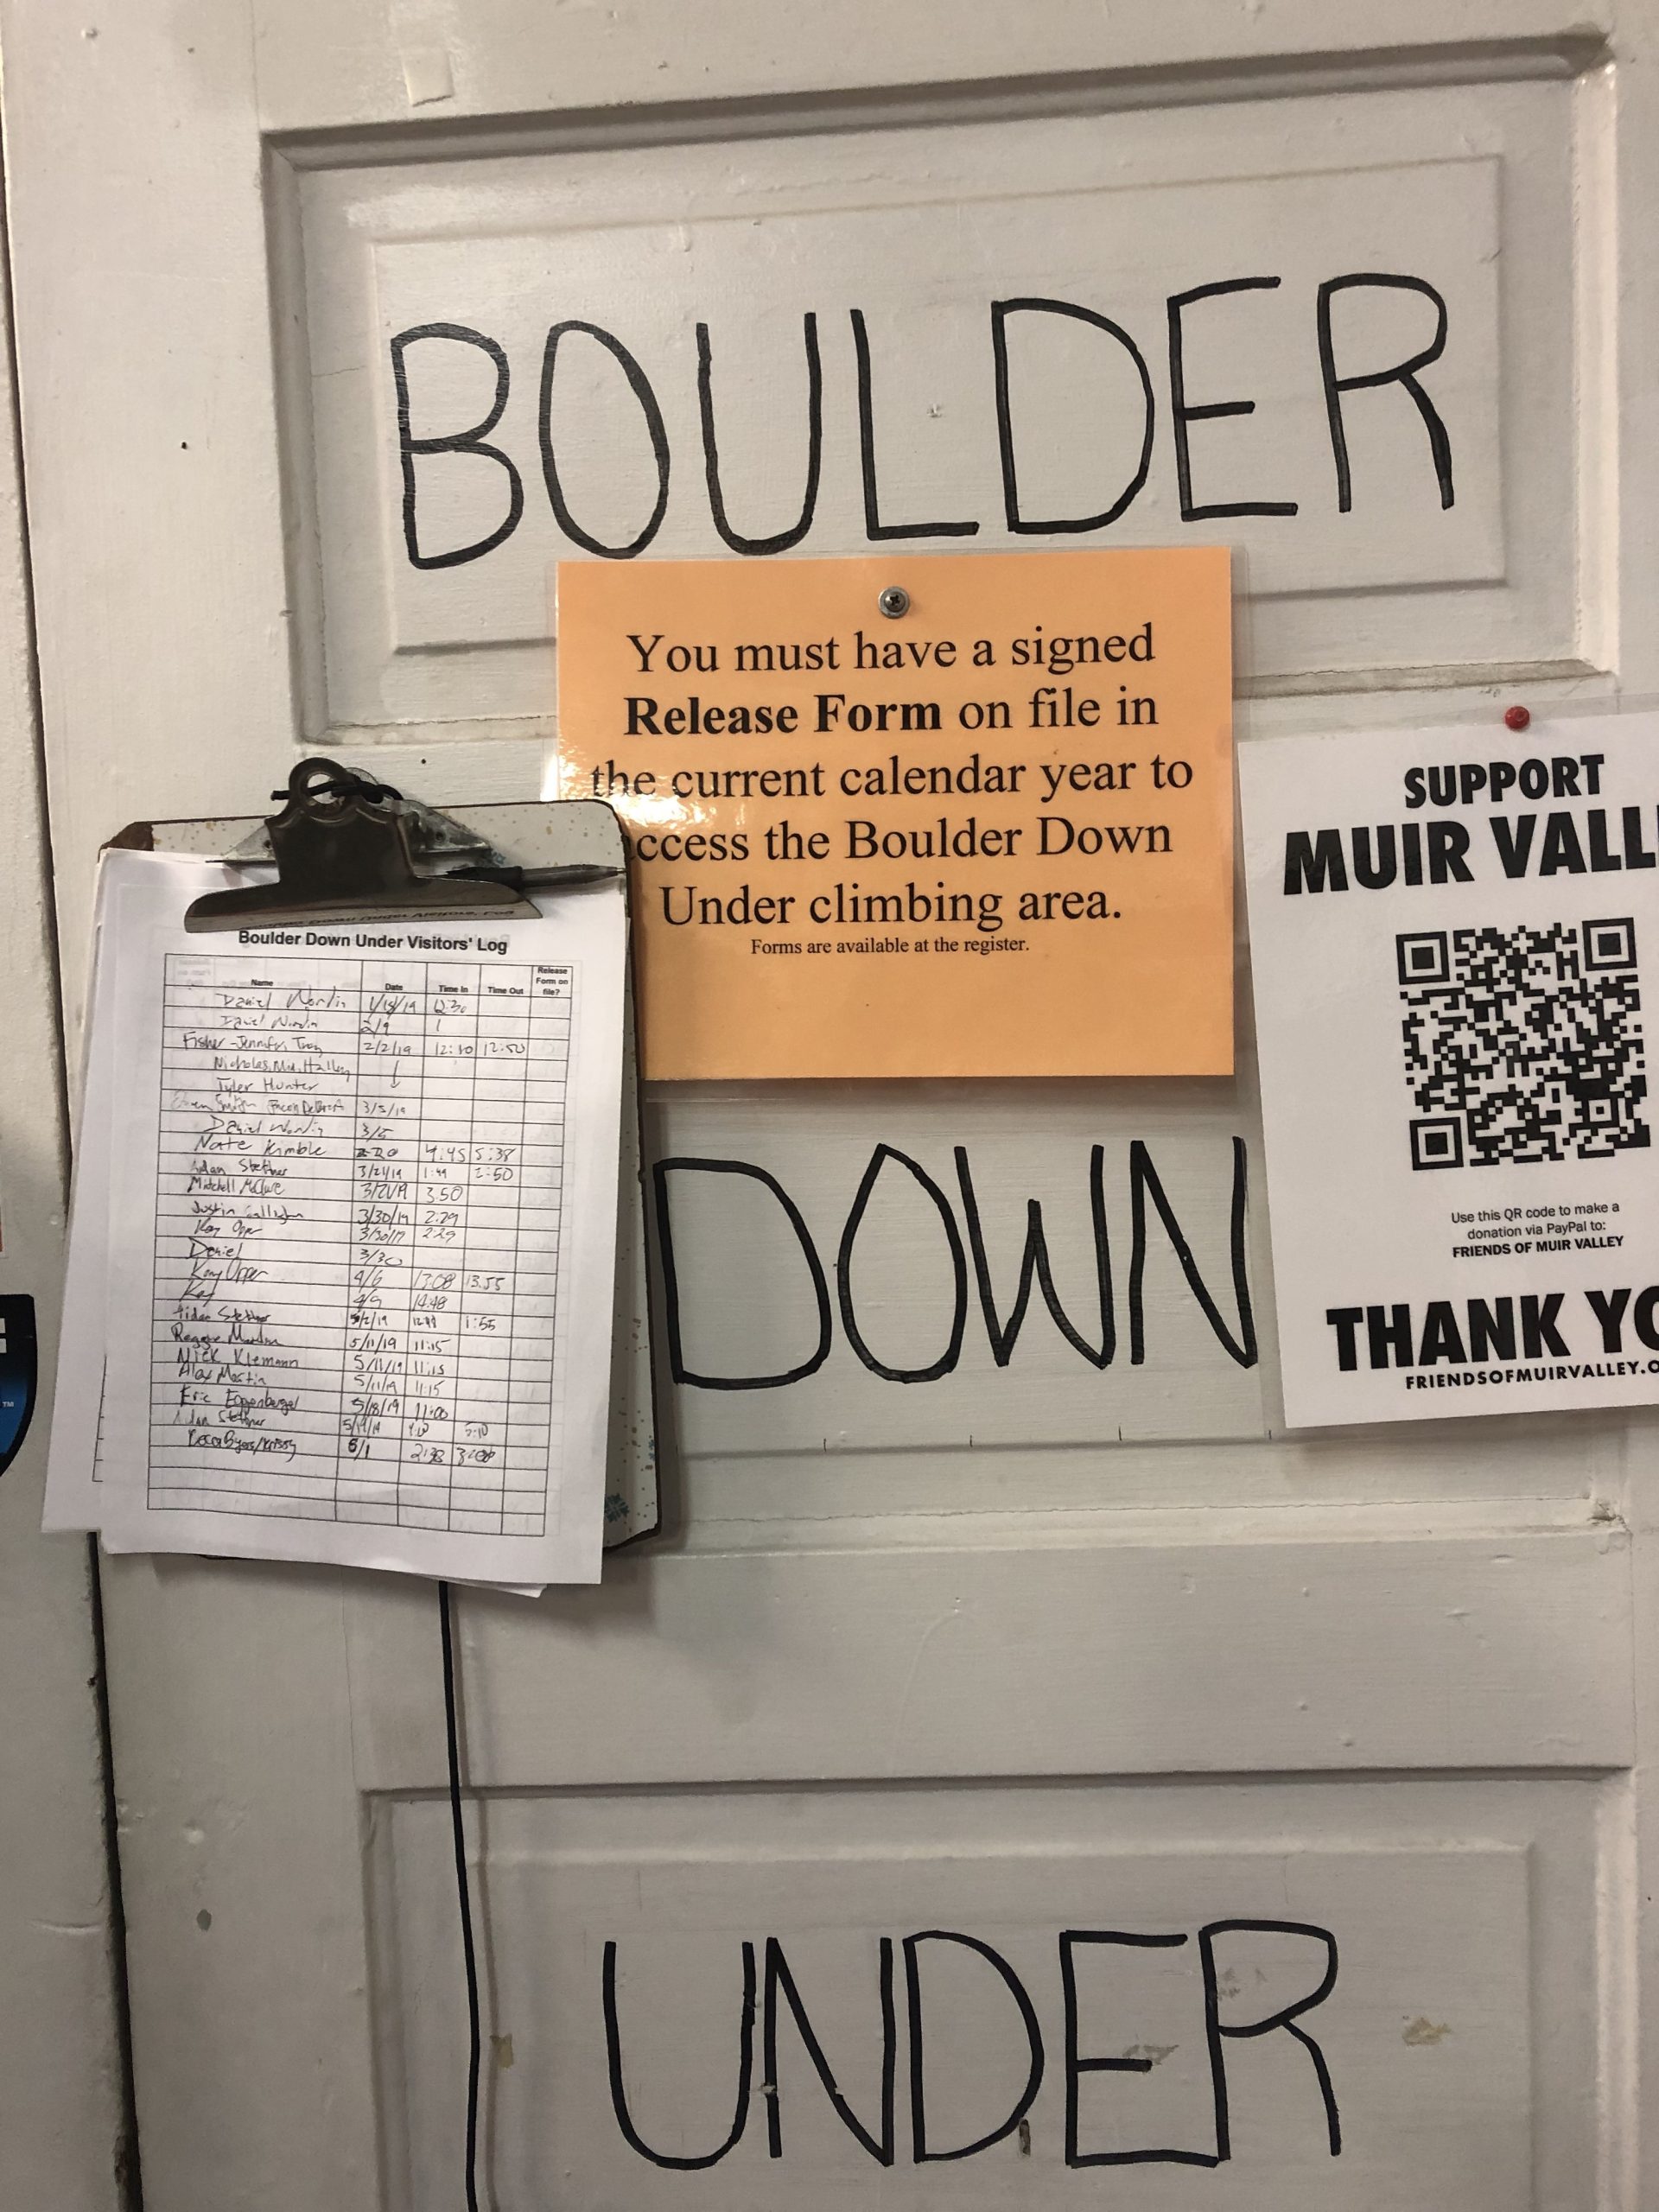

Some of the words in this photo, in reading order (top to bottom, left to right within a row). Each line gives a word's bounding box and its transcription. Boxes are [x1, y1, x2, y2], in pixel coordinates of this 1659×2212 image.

[391, 273, 1454, 571] BOULDER
[626, 634, 720, 672] You
[734, 637, 840, 671] must
[854, 631, 957, 669] have
[972, 639, 996, 666] a
[1012, 622, 1155, 675] signed
[624, 695, 798, 735] Release
[814, 694, 943, 733] Form
[959, 701, 1013, 729] on
[1029, 688, 1101, 728] file
[1116, 685, 1159, 725] in
[592, 760, 656, 798] the
[671, 762, 825, 798] current
[840, 753, 1026, 795] calendar
[1040, 762, 1136, 803] year
[1150, 754, 1193, 790] to
[1404, 753, 1605, 809] SUPPORT
[624, 832, 750, 861] ccess
[764, 820, 830, 860] the
[845, 817, 1022, 859] Boulder
[1037, 817, 1173, 855] Down
[1284, 820, 1475, 895] MUIR
[1489, 804, 1659, 879] VALL
[659, 884, 795, 925] Under
[810, 881, 1003, 932] climbing
[1019, 889, 1122, 920] area.
[238, 930, 302, 945] Boulder
[306, 933, 351, 947] Down
[356, 934, 404, 949] Under
[408, 936, 473, 950] Visitors'
[478, 939, 508, 956] Log
[751, 938, 802, 954] Forms
[807, 943, 831, 953] are
[836, 938, 908, 953] available
[914, 939, 929, 952] at
[934, 937, 959, 952] the
[964, 936, 1030, 956] register.
[439, 984, 460, 993] Time
[488, 986, 507, 995] Time
[510, 987, 524, 995] Out
[537, 966, 568, 976] Release
[1452, 1212, 1474, 1224] Use
[1478, 1210, 1501, 1223] this
[1504, 1208, 1522, 1221] QR
[1526, 1205, 1555, 1219] code
[1559, 1205, 1571, 1216] to
[1574, 1202, 1608, 1215] make
[1612, 1203, 1620, 1212] a
[1467, 1225, 1522, 1240] donation
[1526, 1224, 1543, 1236] via
[1547, 1221, 1587, 1236] PayPal
[1590, 1221, 1606, 1231] to:
[653, 1135, 1258, 1389] DOWN
[1452, 1243, 1511, 1258] FRIENDS
[1515, 1242, 1533, 1255] OF
[1536, 1239, 1571, 1253] MUIR
[1574, 1236, 1624, 1249] VALLEY
[1326, 1293, 1571, 1371] THANK
[603, 1919, 1340, 2170] UNDER
